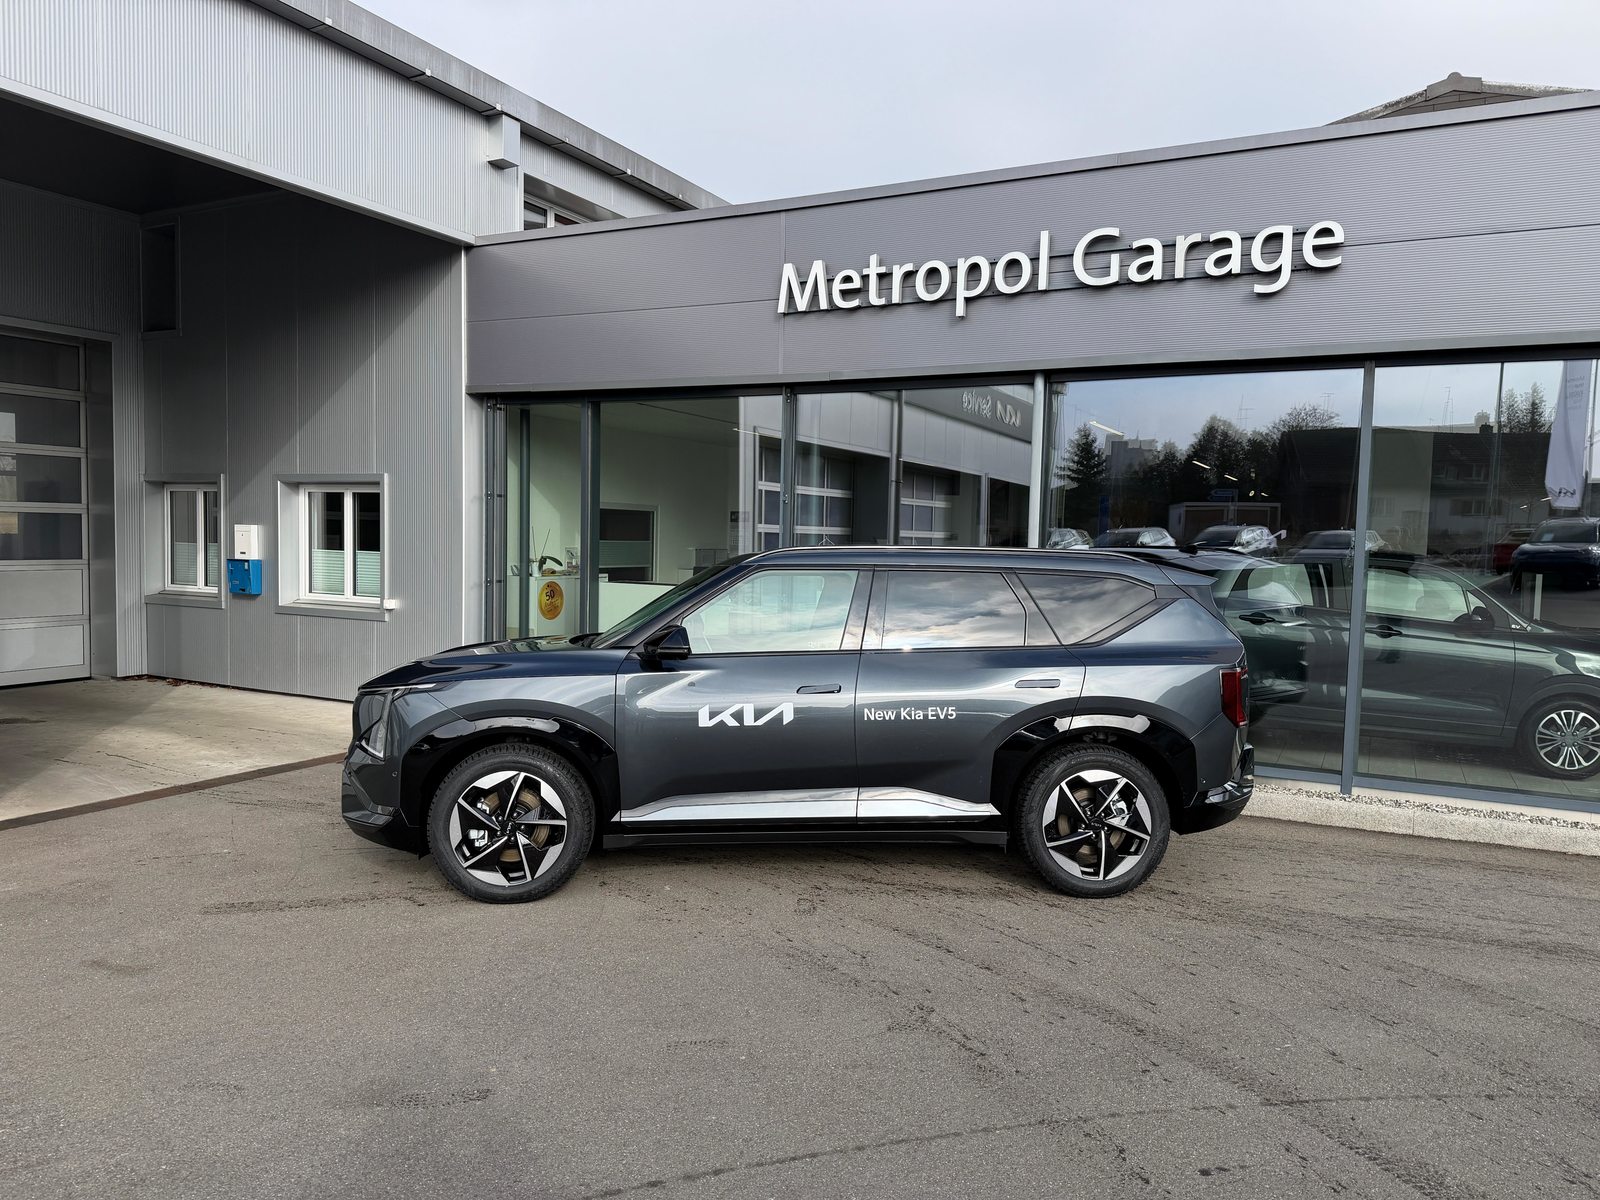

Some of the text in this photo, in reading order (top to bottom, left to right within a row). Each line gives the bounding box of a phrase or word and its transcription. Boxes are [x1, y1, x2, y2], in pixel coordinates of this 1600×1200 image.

[777, 219, 1345, 317] Metropol Garage
[545, 589, 555, 602] 50
[697, 702, 794, 728] KIA
[863, 706, 957, 721] New Kia EV5
